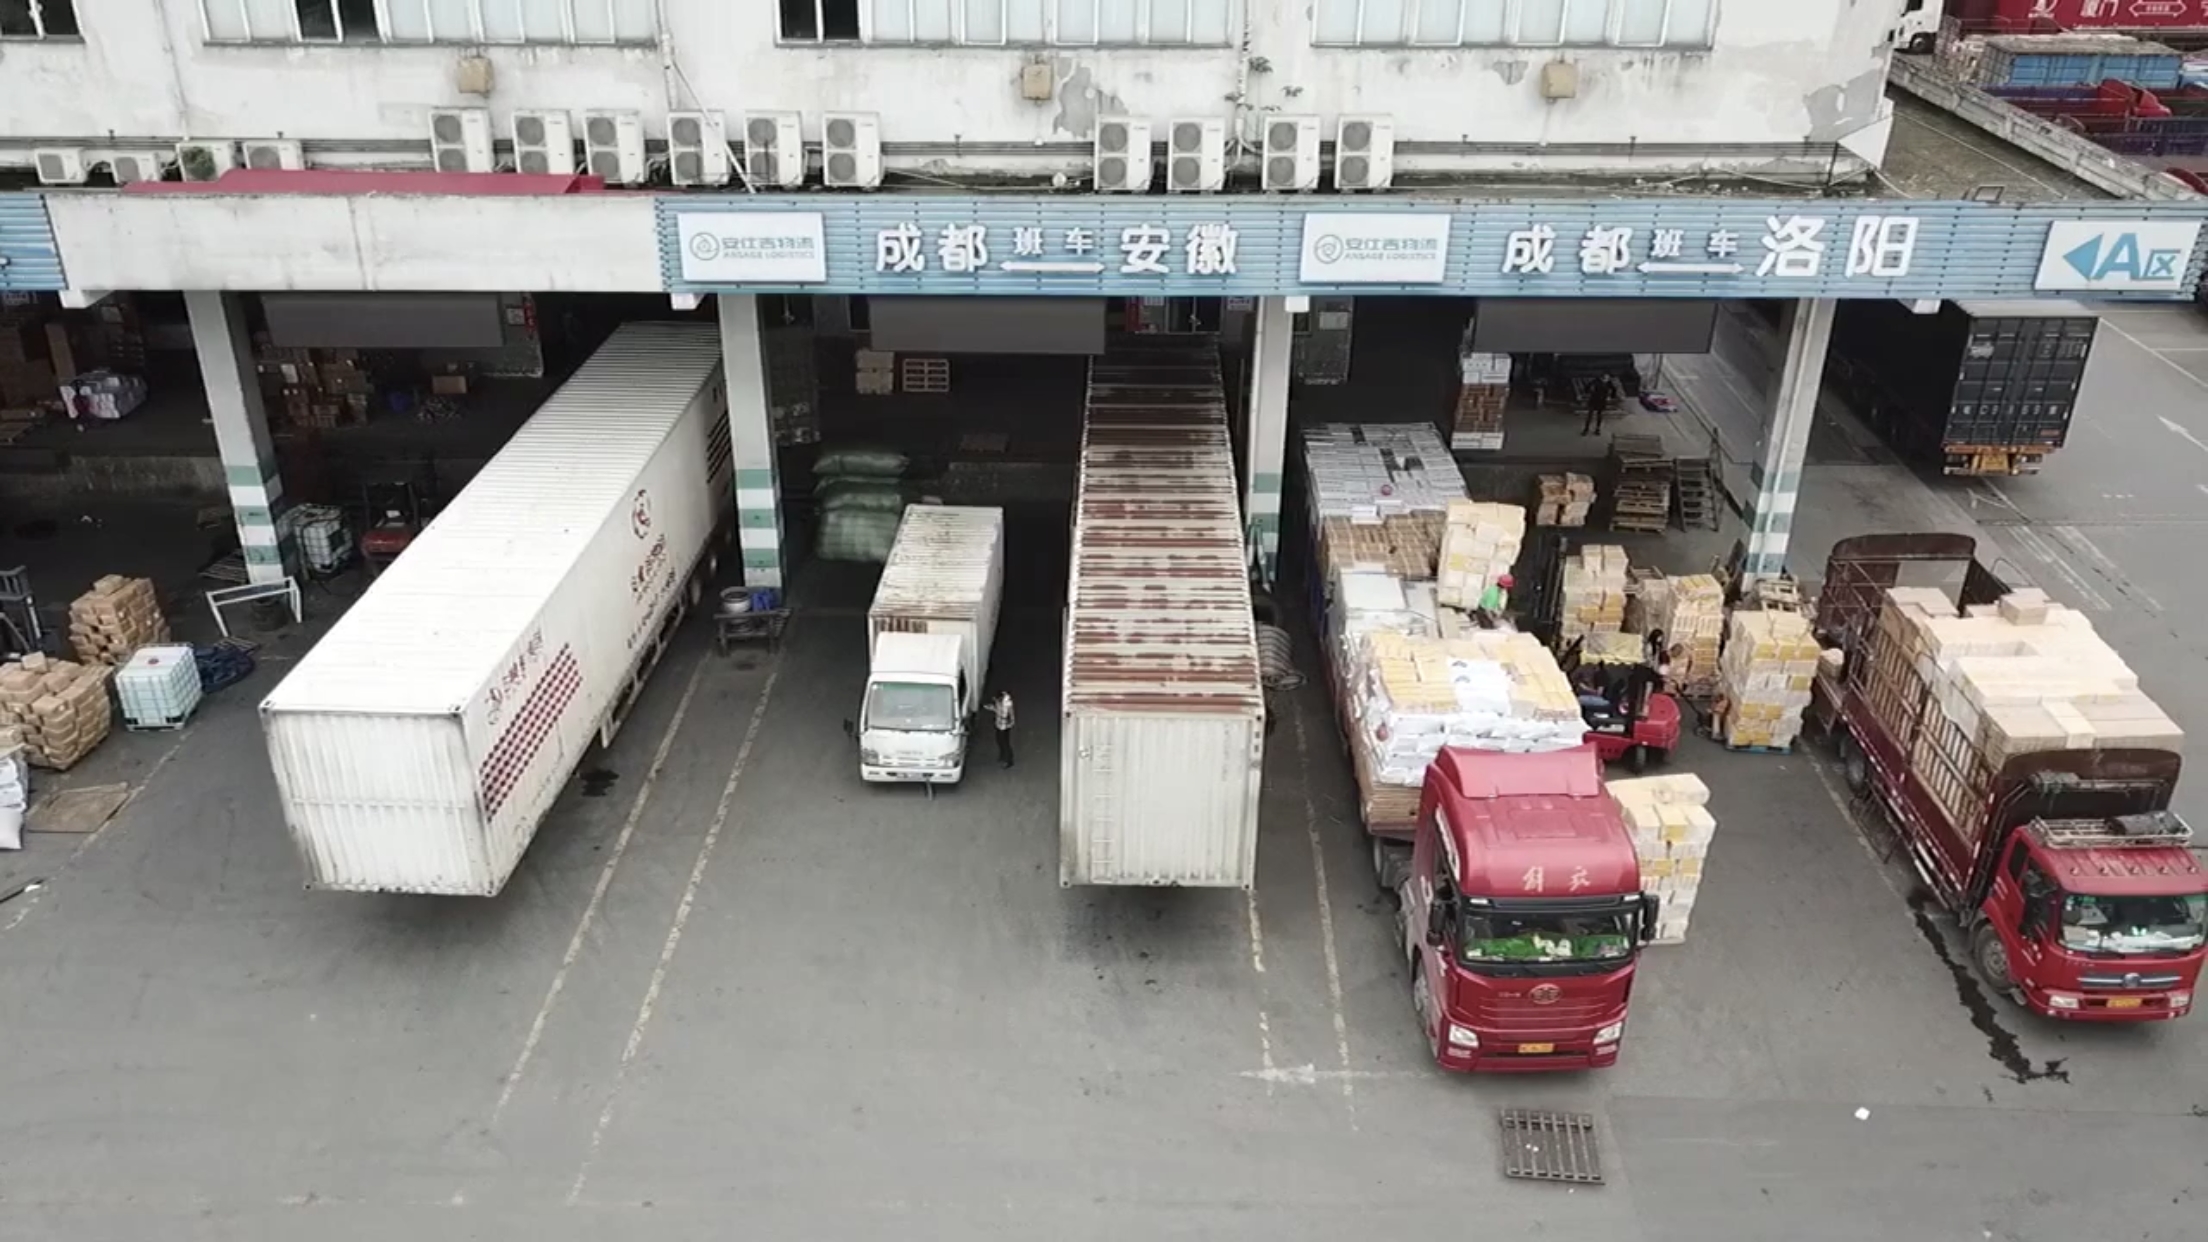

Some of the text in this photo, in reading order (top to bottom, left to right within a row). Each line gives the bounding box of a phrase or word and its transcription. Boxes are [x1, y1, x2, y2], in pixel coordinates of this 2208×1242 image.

[876, 222, 1239, 275] 成都 班车 安徽
[1502, 214, 1919, 278] 成都 班车 洛阳
[2092, 233, 2182, 281] A区
